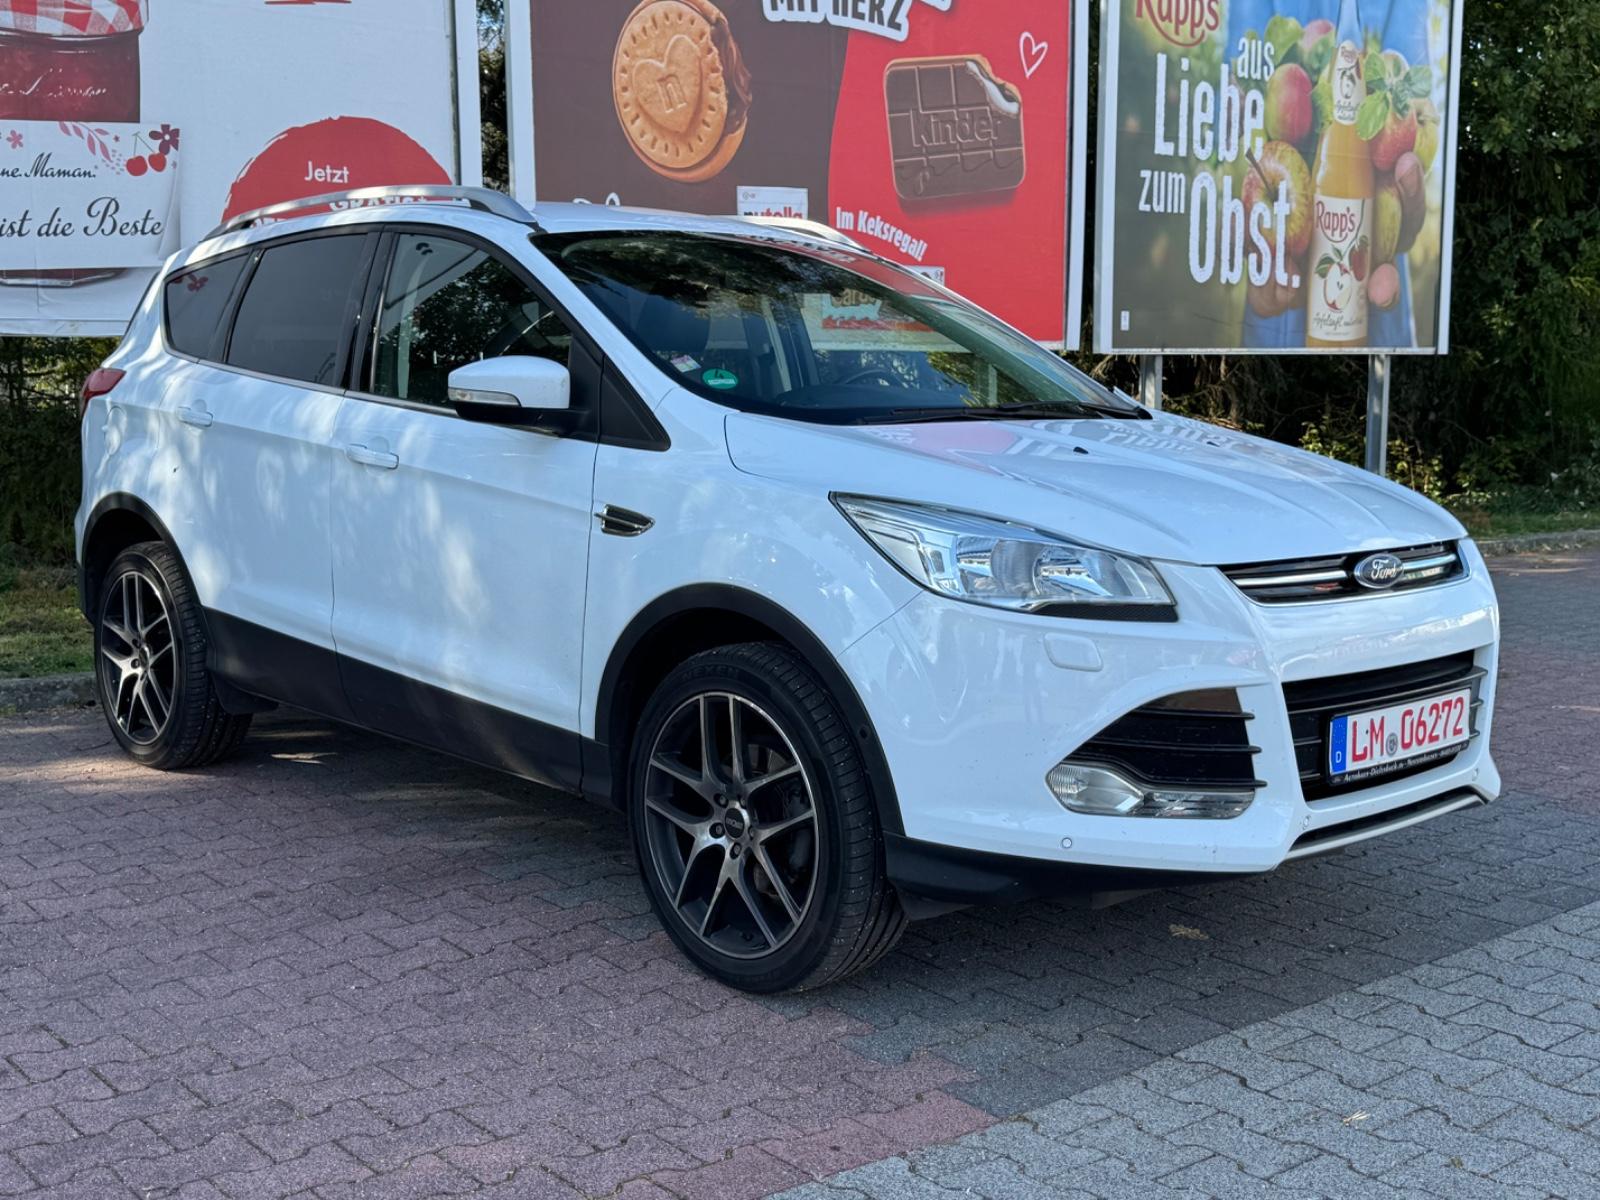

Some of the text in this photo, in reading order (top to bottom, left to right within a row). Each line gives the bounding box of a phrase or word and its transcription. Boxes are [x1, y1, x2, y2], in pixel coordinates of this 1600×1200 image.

[1237, 37, 1275, 82] aus
[908, 109, 1001, 147] kinder
[1154, 53, 1265, 162] Liebe
[304, 161, 350, 184] Jetzt
[0, 197, 165, 237] ist die Beste
[836, 206, 854, 231] Im
[857, 210, 928, 262] Keksregal!
[1139, 170, 1300, 288] zum Obst.
[1316, 201, 1355, 243] Rapp's
[1371, 559, 1398, 580] Ford
[1352, 715, 1385, 763] LM
[1401, 696, 1465, 751] 06272
